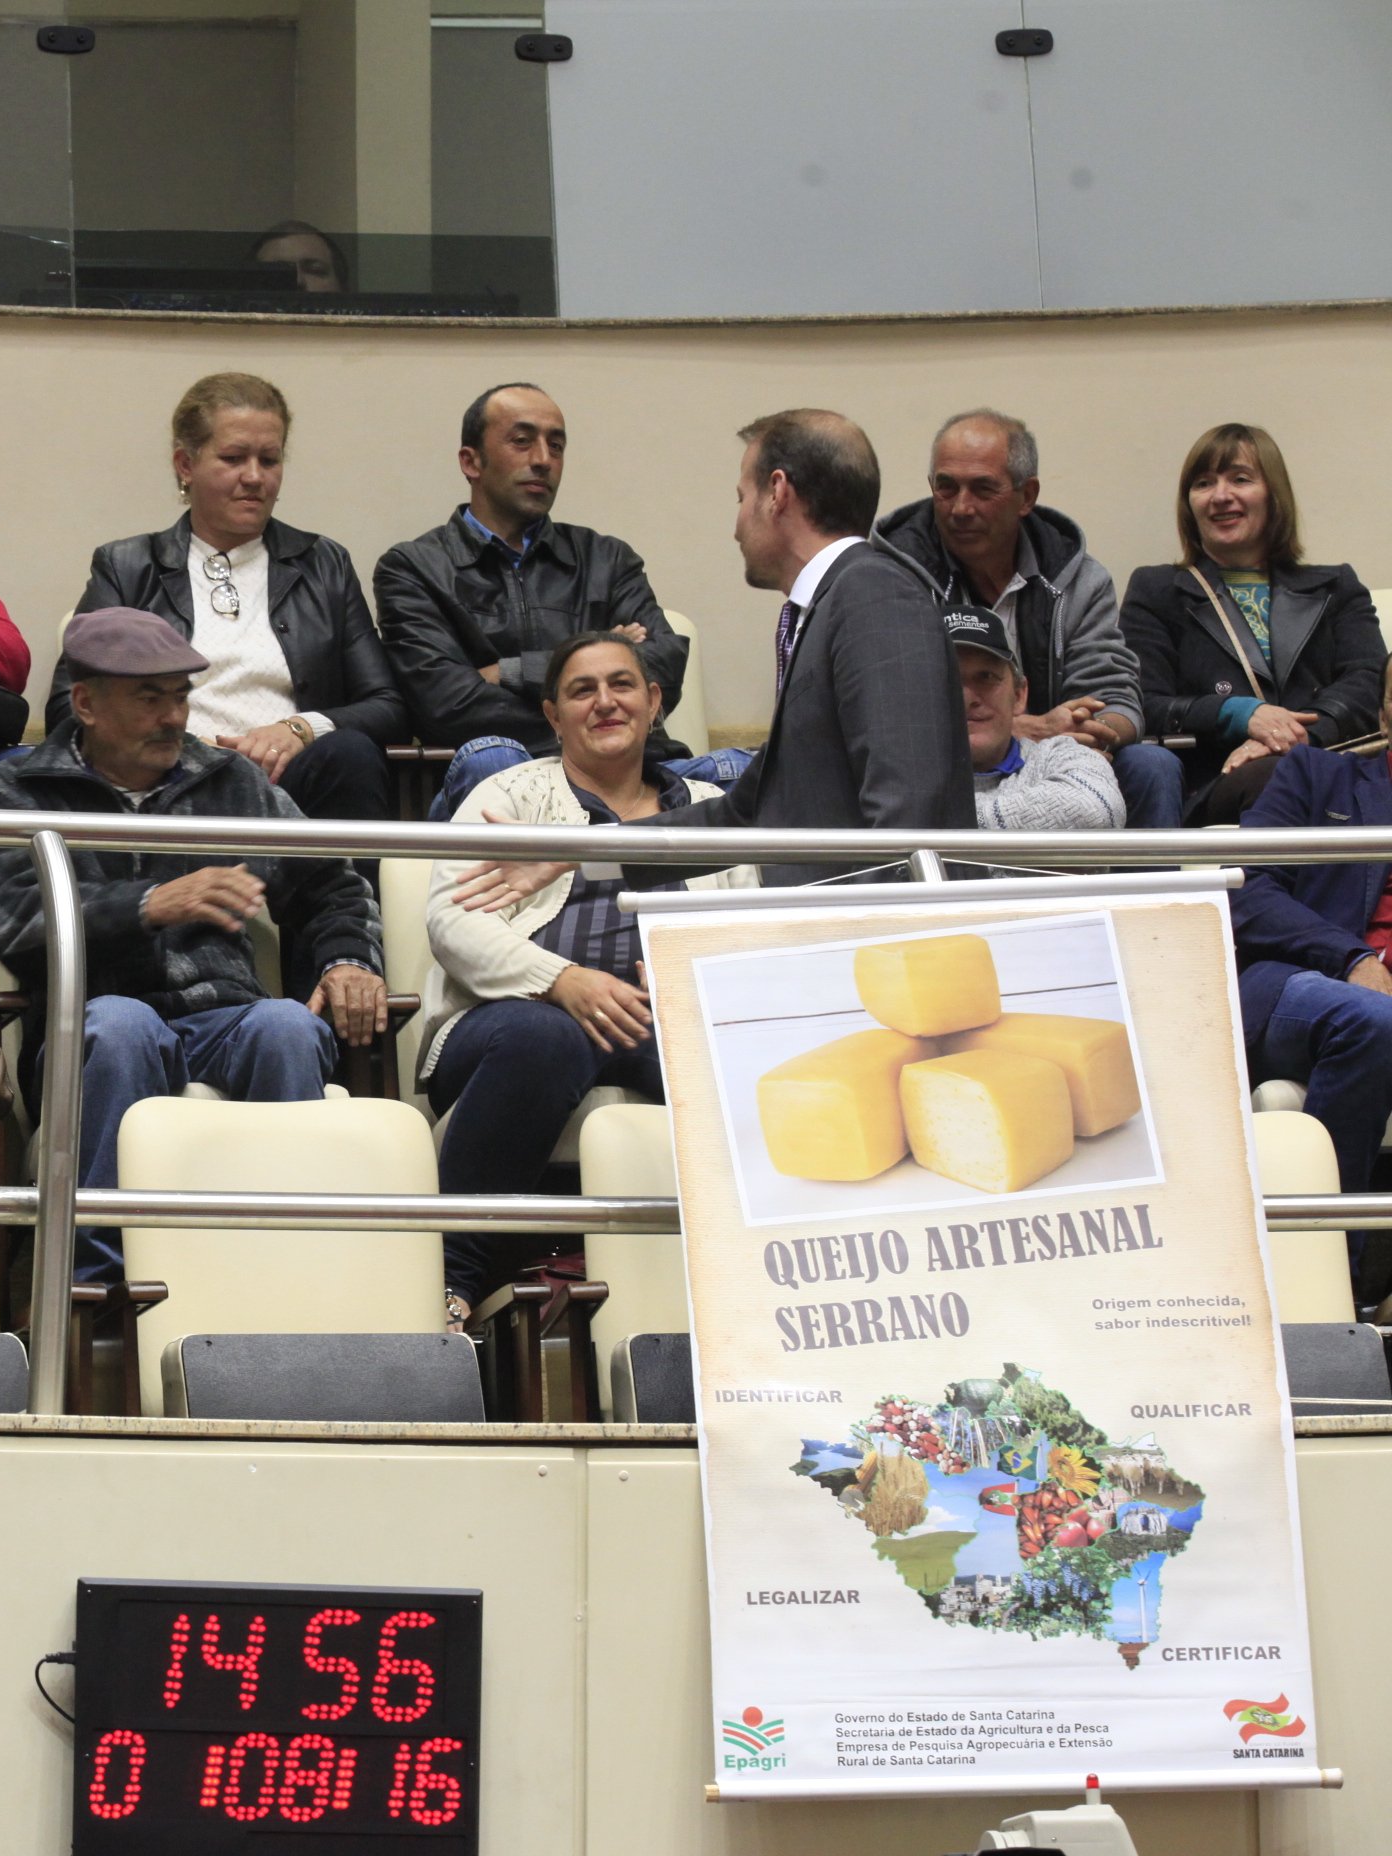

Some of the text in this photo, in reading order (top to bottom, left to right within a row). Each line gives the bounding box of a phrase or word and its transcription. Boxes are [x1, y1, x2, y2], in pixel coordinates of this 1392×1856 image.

[944, 613, 979, 623] ntica
[762, 1203, 1164, 1291] QUEIJO ARTESANAL
[1092, 1295, 1246, 1311] Origem conhecida,
[773, 1291, 971, 1353] SERRANO
[1094, 1318, 1141, 1331] sabor
[715, 1390, 843, 1403] IDENTIFICAR
[1130, 1403, 1252, 1419] QUALIFICAR
[745, 1588, 860, 1606] LEGALIZAR
[1161, 1644, 1282, 1662] CERTIFICAR
[164, 1608, 435, 1722] 14 56
[835, 1710, 1055, 1723] Governo do Estado de Santa Catarina
[836, 1723, 1109, 1738] Secretaria de Estado da Agricultura da Pesca
[837, 1737, 1113, 1754] Empresa de Pesquisa Agropecuária Extensão
[1233, 1748, 1304, 1758] SANTA CATARINA
[724, 1753, 786, 1771] Epagri
[837, 1754, 976, 1766] Rural de Santa Catarina
